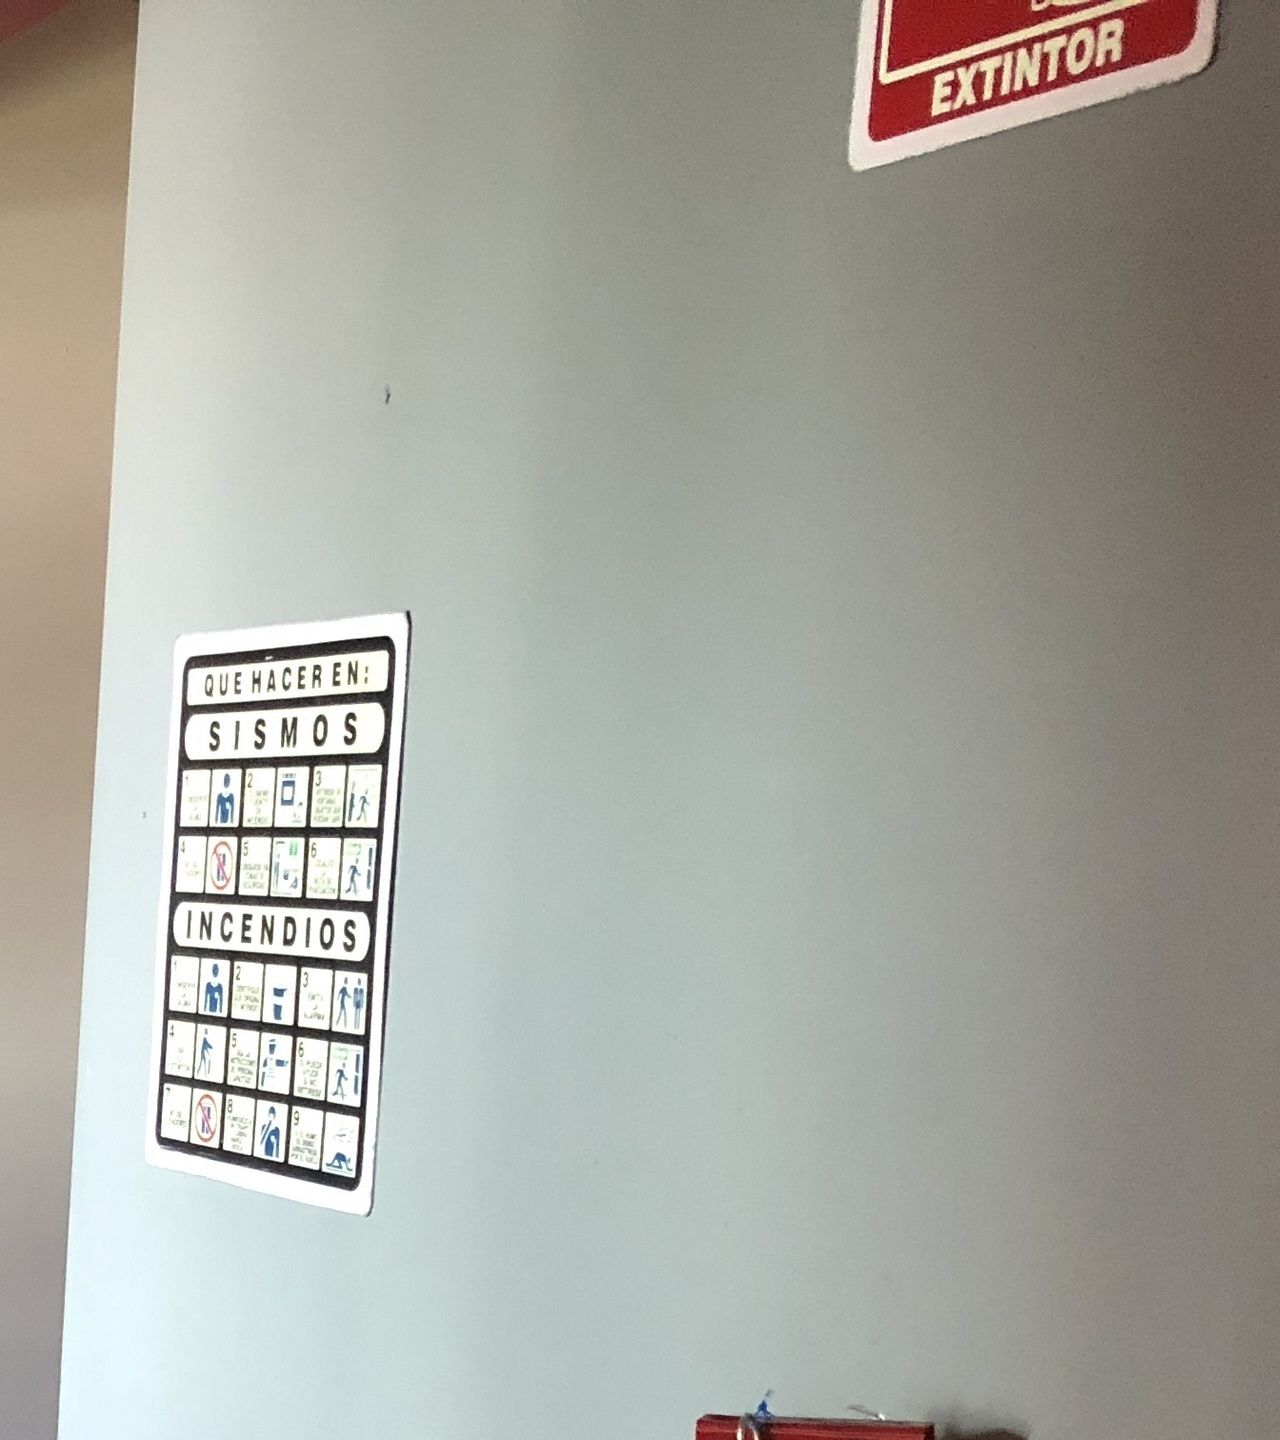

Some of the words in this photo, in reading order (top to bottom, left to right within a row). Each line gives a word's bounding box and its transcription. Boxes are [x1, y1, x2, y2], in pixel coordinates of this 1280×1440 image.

[930, 19, 1125, 117] EXTINTOR
[204, 671, 243, 697] QUE
[251, 664, 322, 693] HACER
[332, 660, 369, 687] EN:
[208, 712, 358, 752] SISMOS
[247, 774, 254, 789] 2
[315, 770, 322, 787] 3
[243, 841, 249, 857] 5
[310, 842, 317, 858] 6
[186, 910, 357, 953] INCENDIOS
[235, 965, 241, 981] 2
[303, 972, 309, 987] 3
[231, 1033, 237, 1048] 5
[298, 1041, 304, 1058] 6
[227, 1098, 233, 1113] 8
[293, 1110, 300, 1126] 9
